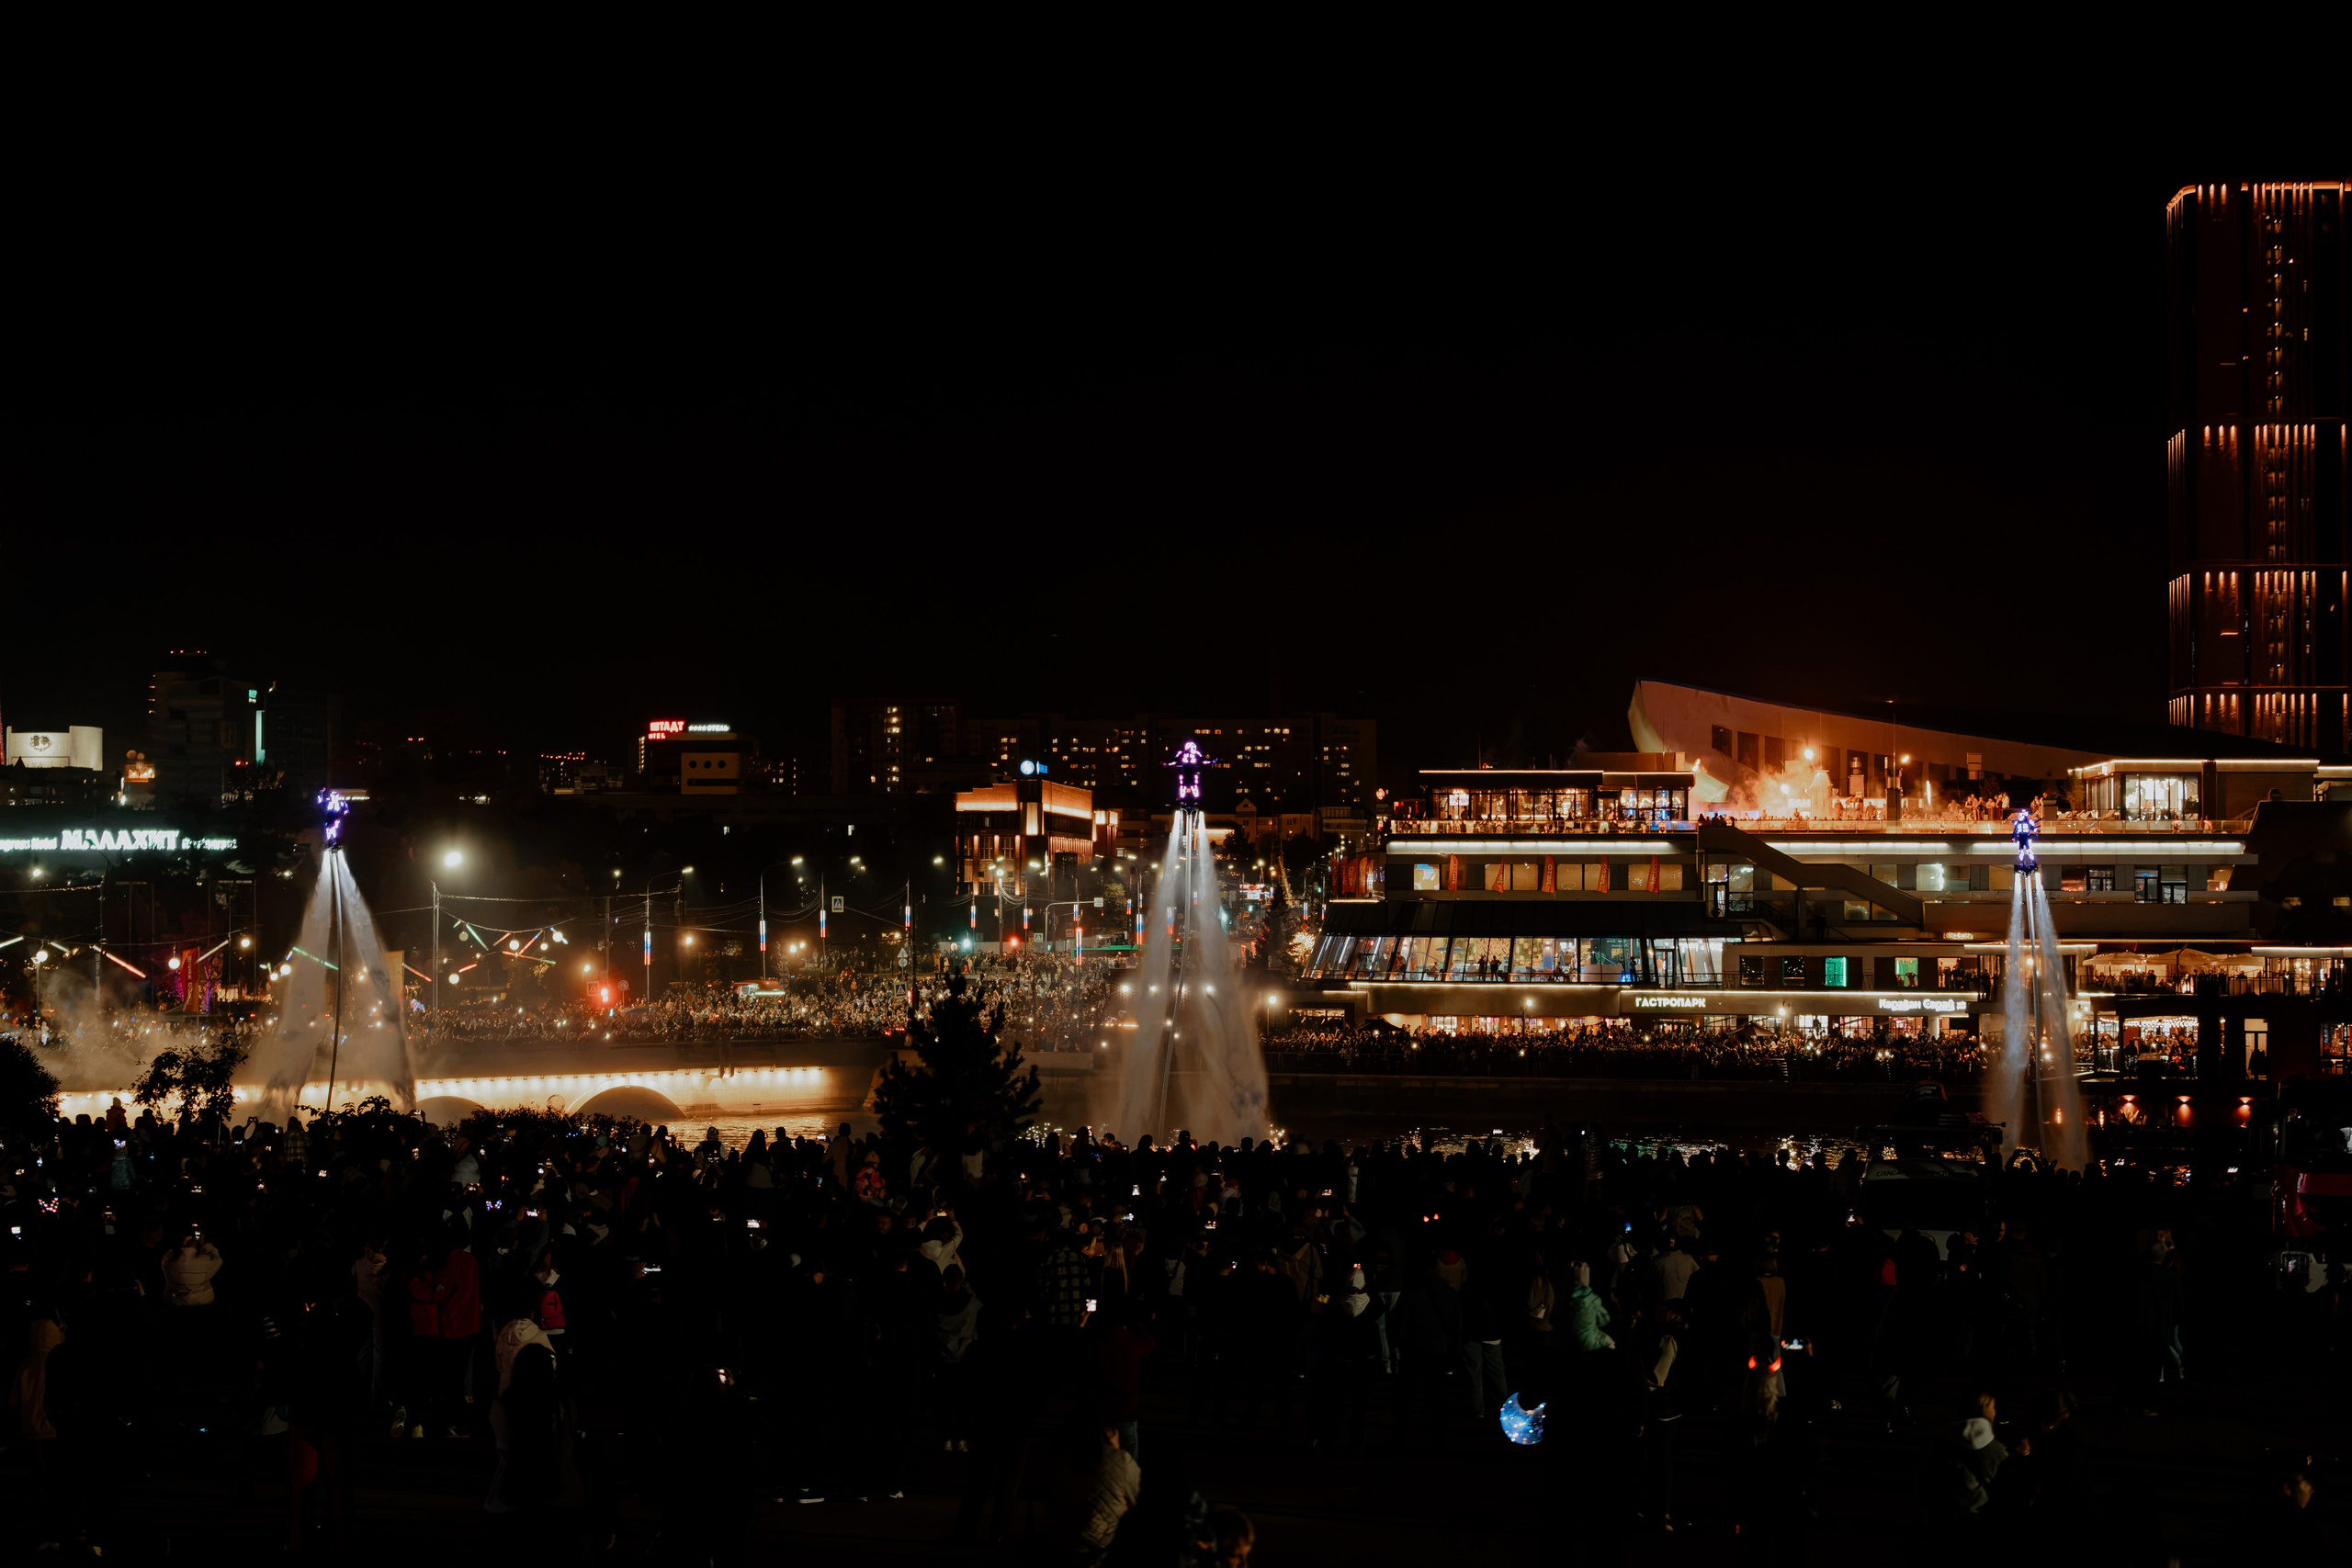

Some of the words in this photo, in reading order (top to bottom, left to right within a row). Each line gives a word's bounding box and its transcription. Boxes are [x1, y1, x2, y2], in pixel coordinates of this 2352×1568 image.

[650, 721, 684, 732] ШТАДТ
[707, 724, 729, 732] ОТЕЛЬ
[1635, 997, 1706, 1008] ГАСТРОПАРК
